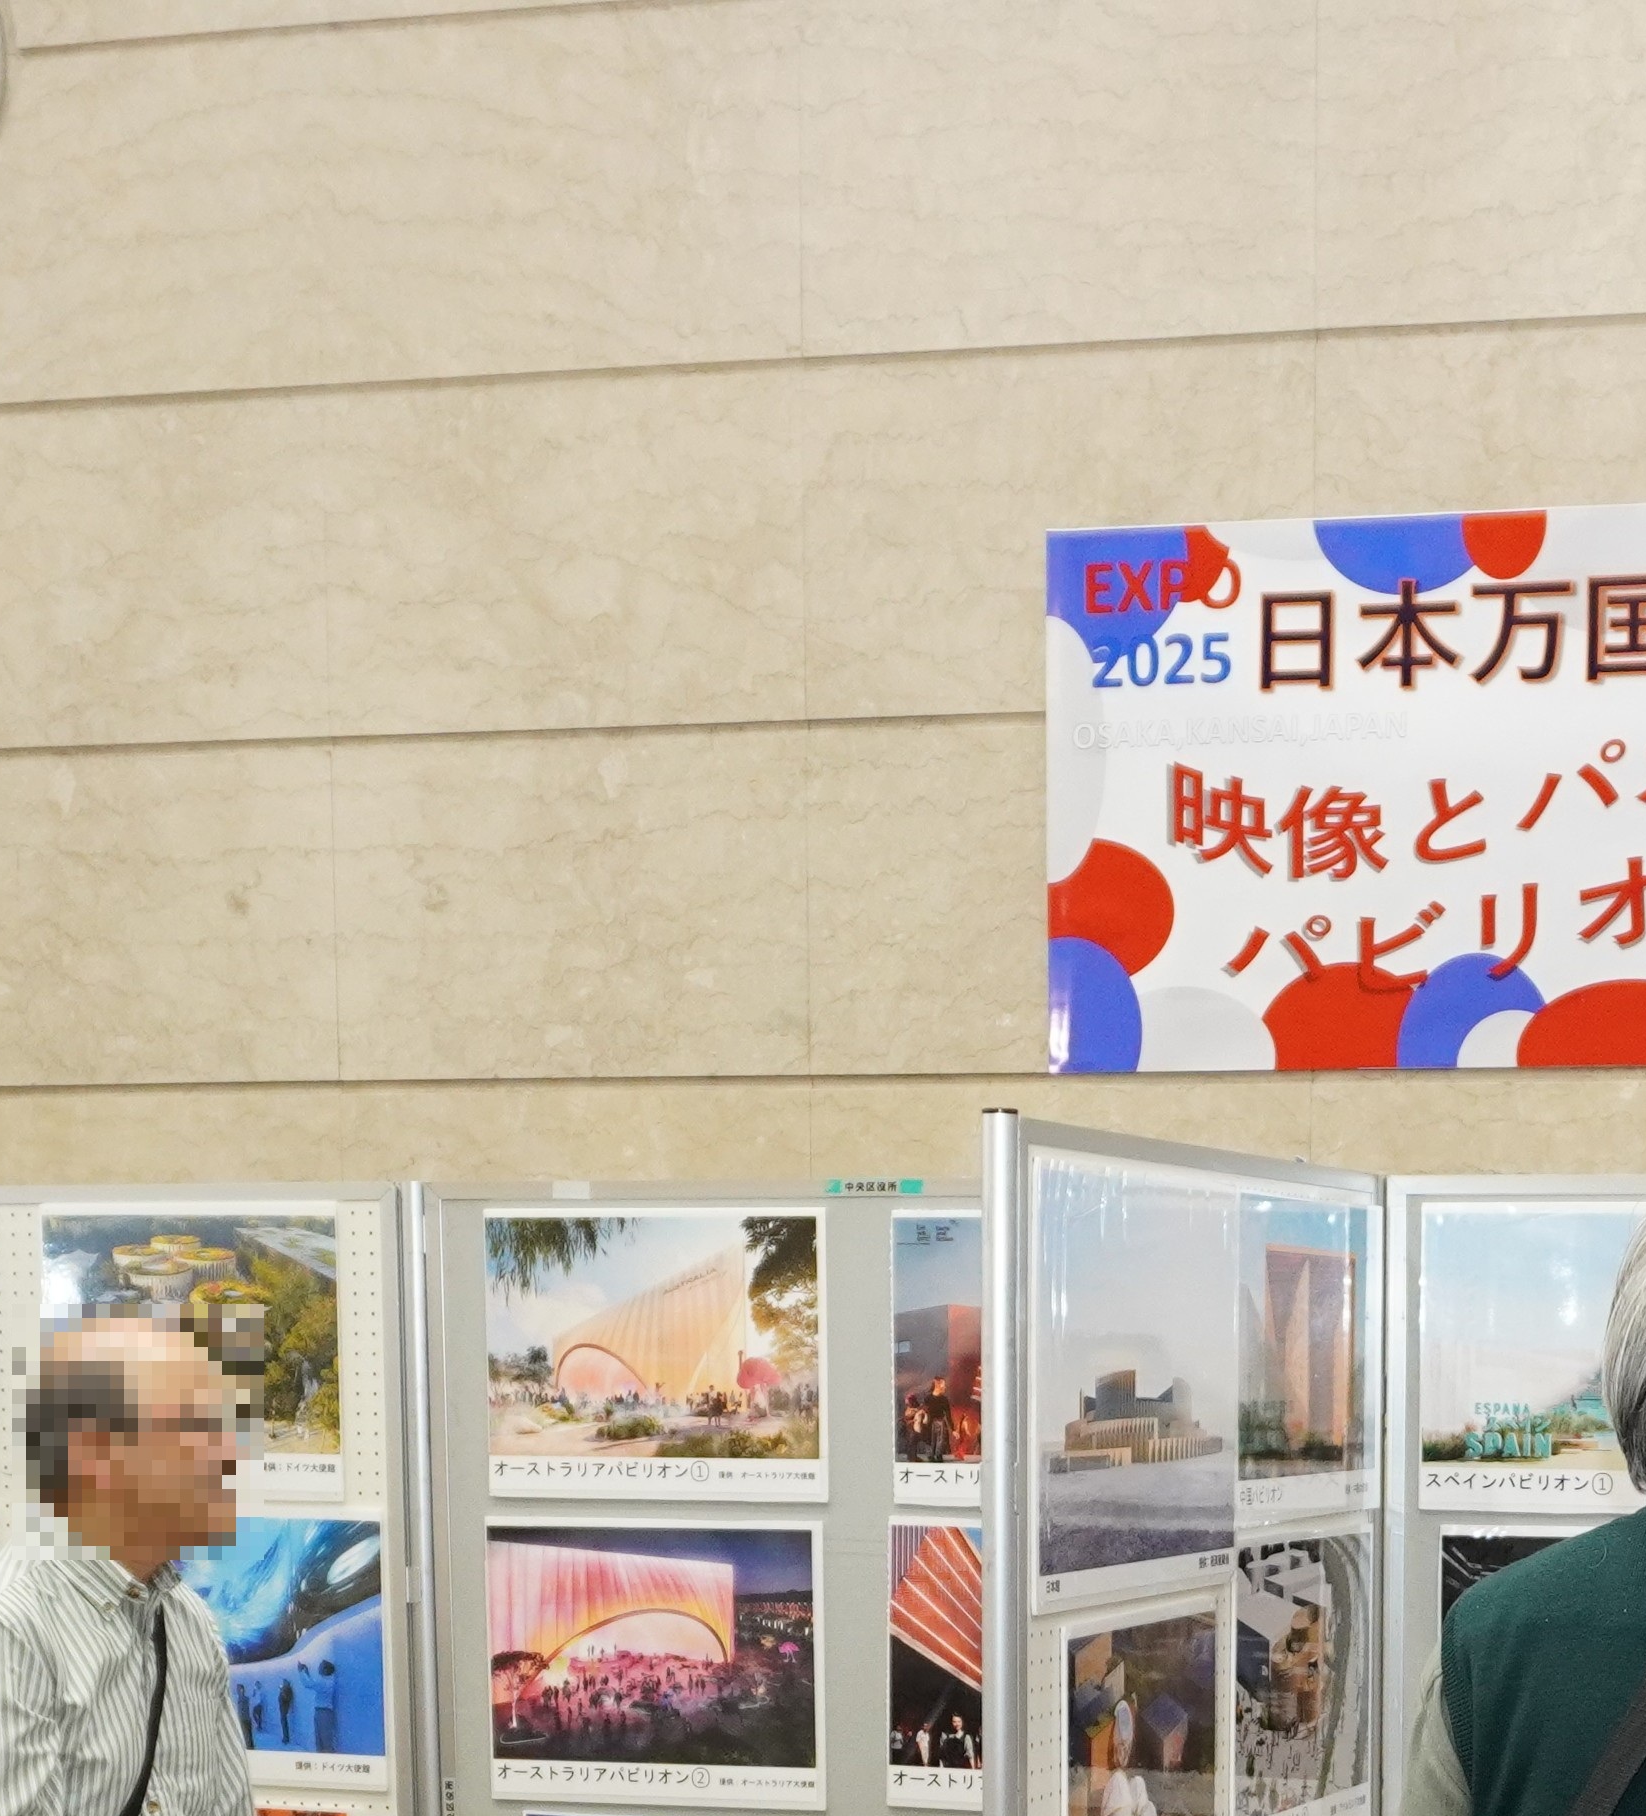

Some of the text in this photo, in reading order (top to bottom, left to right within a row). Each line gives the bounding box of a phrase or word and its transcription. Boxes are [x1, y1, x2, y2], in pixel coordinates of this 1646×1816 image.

[1085, 557, 1242, 615] EXPO
[1091, 632, 1232, 689] 2025
[844, 1181, 897, 1192] 中央区役所
[1464, 1431, 1552, 1459] SPAIN
[264, 1462, 336, 1473] 供：ドイツ大使館
[494, 1459, 710, 1482] オーストラリアパビリオン①
[1426, 1471, 1613, 1495] スペインパビリオン①
[497, 1764, 711, 1788] オーストラリアパビリオン②
